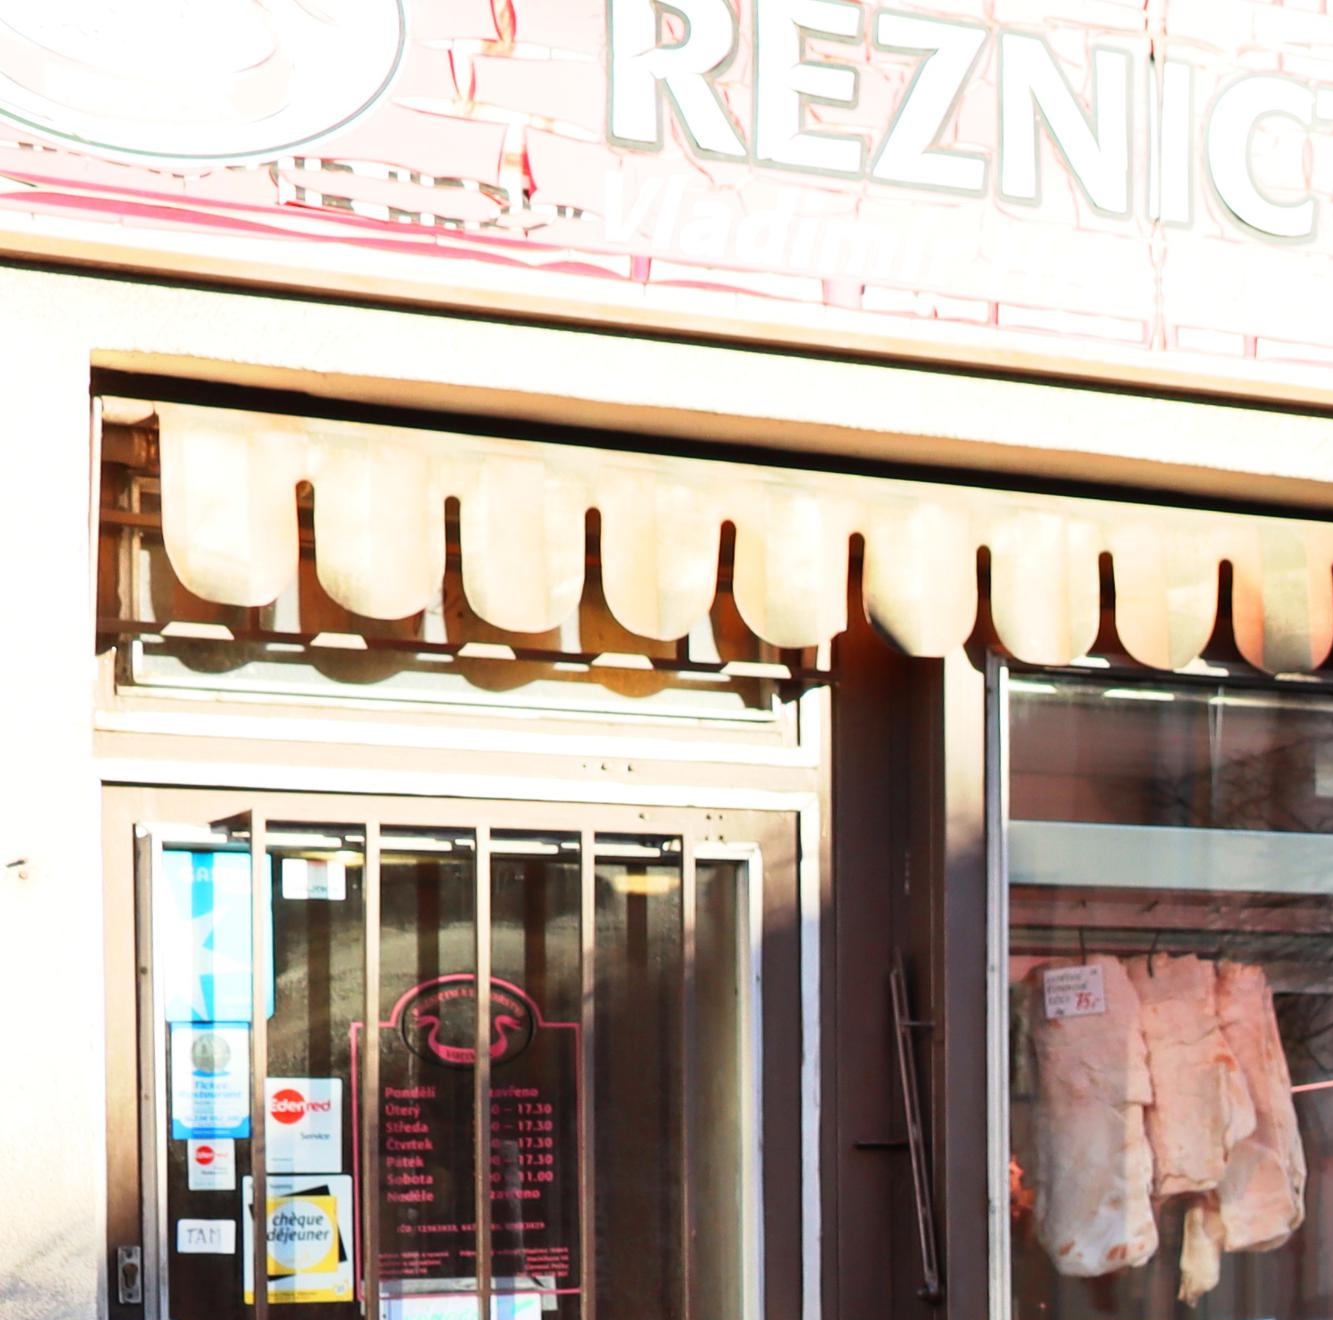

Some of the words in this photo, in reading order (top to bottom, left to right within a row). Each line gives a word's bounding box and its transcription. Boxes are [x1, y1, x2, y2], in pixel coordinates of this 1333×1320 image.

[385, 1086, 436, 1099] Pondělí
[271, 1099, 331, 1113] Edenred
[385, 1102, 420, 1118] Úterý
[385, 1120, 429, 1133] Středa
[386, 1173, 434, 1186] Sobota
[272, 1212, 324, 1228] chèque
[267, 1229, 331, 1244] déjeuner
